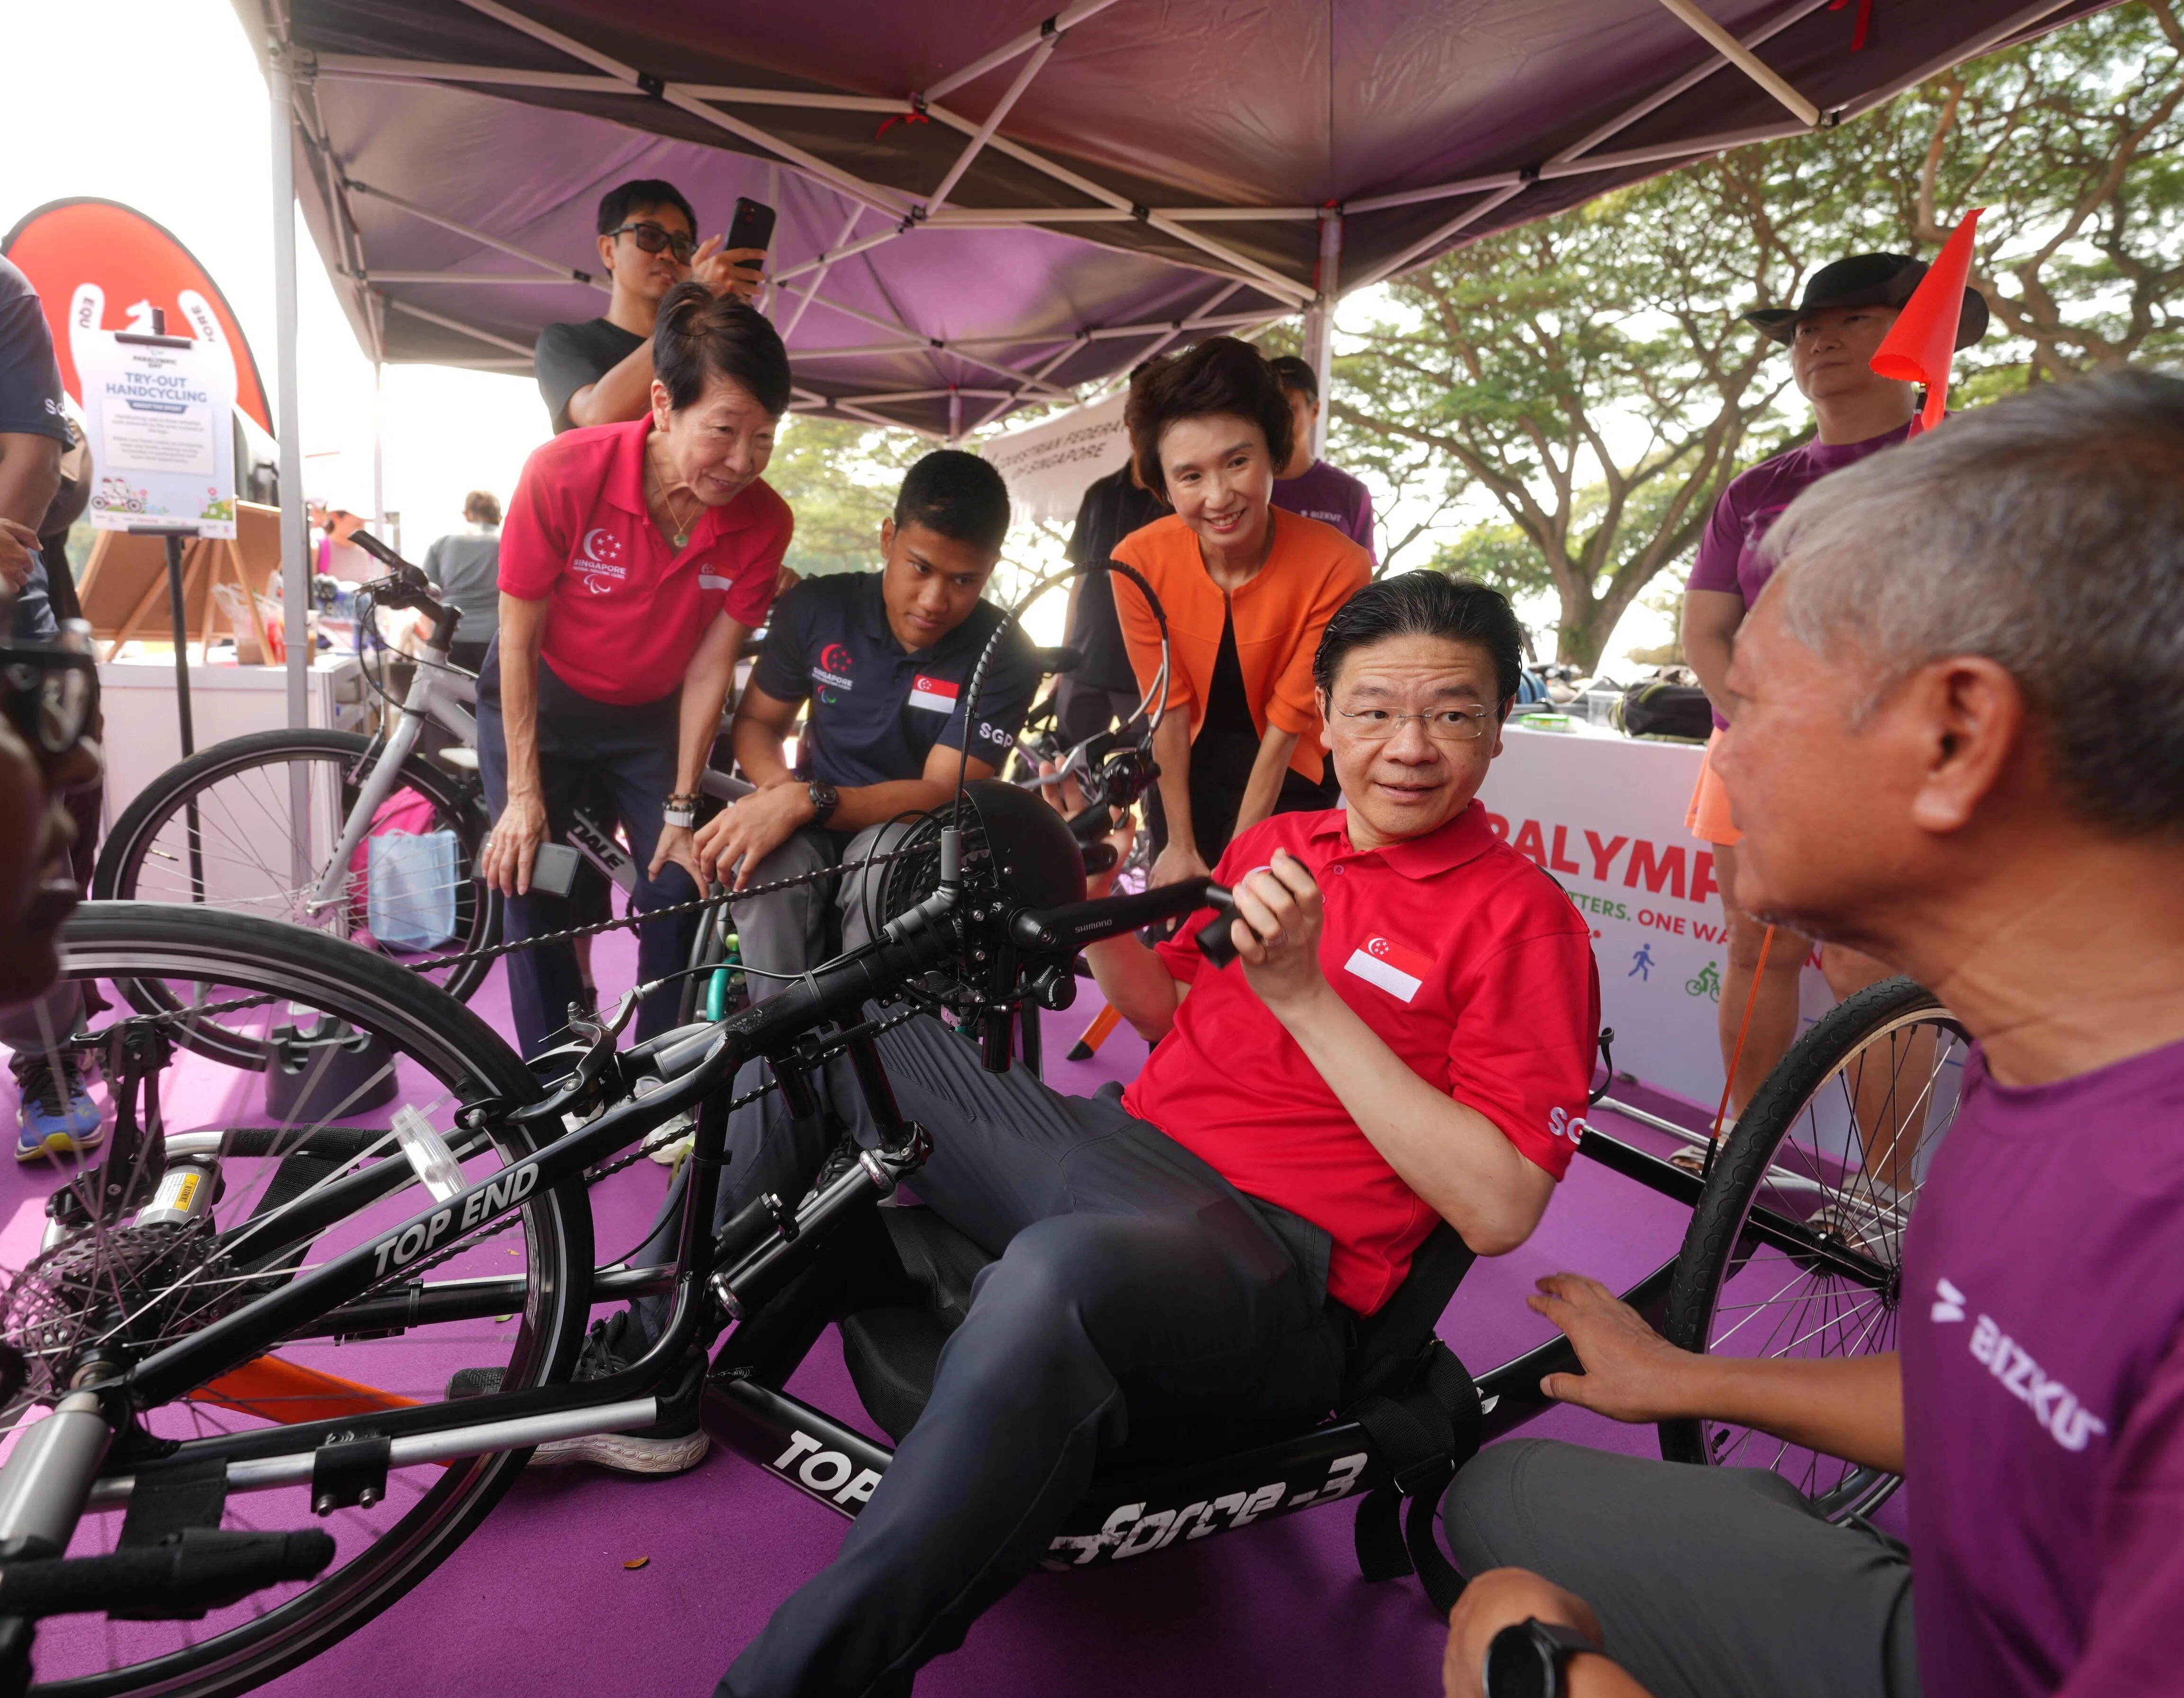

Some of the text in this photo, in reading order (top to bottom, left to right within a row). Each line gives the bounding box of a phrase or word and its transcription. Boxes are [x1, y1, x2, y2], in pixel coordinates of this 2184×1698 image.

[125, 372, 187, 388] TRY-OUT
[106, 382, 207, 403] HANDCYCLING
[1027, 441, 1107, 475] SINGAPORE
[573, 558, 627, 575] SINGAPORE
[813, 666, 854, 688] SINGAPORE
[979, 722, 1013, 748] SGP
[1075, 919, 1112, 933] SHIMANO
[1638, 909, 1686, 936] ONE
[1038, 965, 1054, 984] SHIMANO
[178, 1185, 193, 1203] WARNING
[374, 1162, 539, 1278] TOP END
[773, 1430, 883, 1505] TOP
